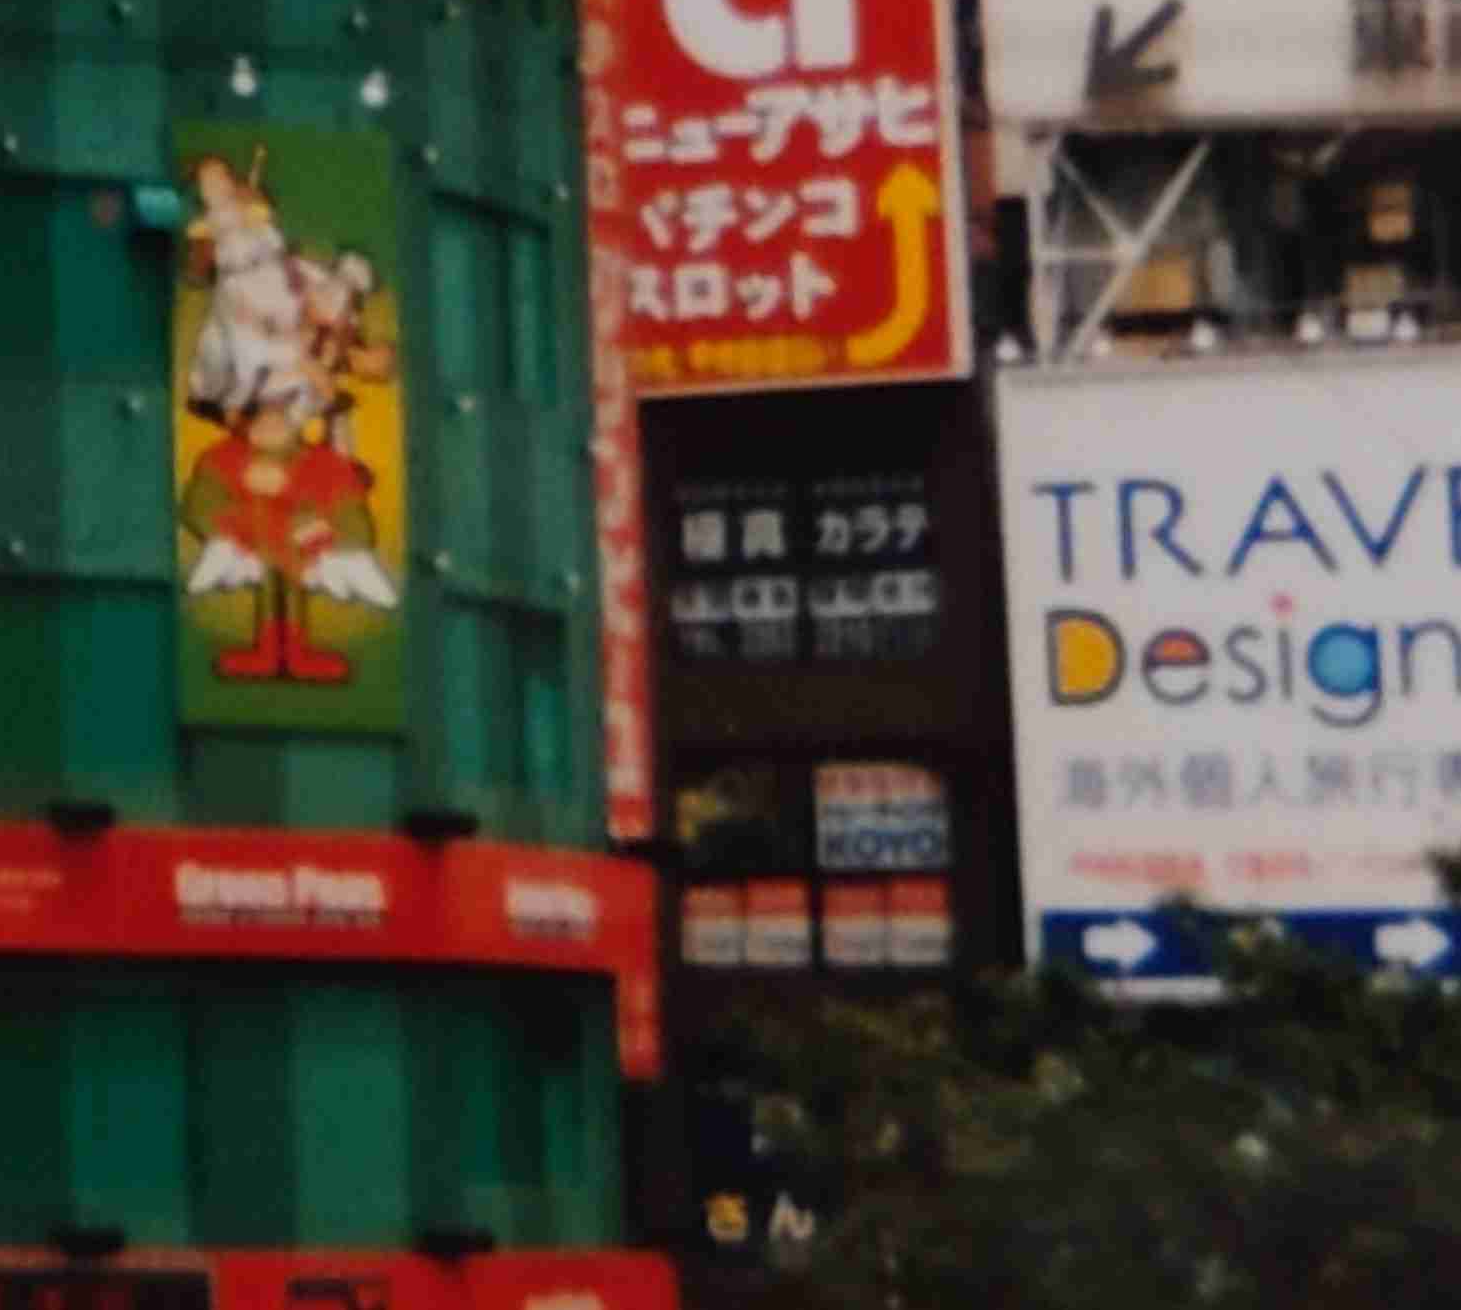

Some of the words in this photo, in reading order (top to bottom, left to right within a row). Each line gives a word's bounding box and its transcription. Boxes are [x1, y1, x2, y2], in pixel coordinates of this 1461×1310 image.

[622, 72, 938, 166] ニューアサヒ
[1045, 593, 1461, 729] Design
